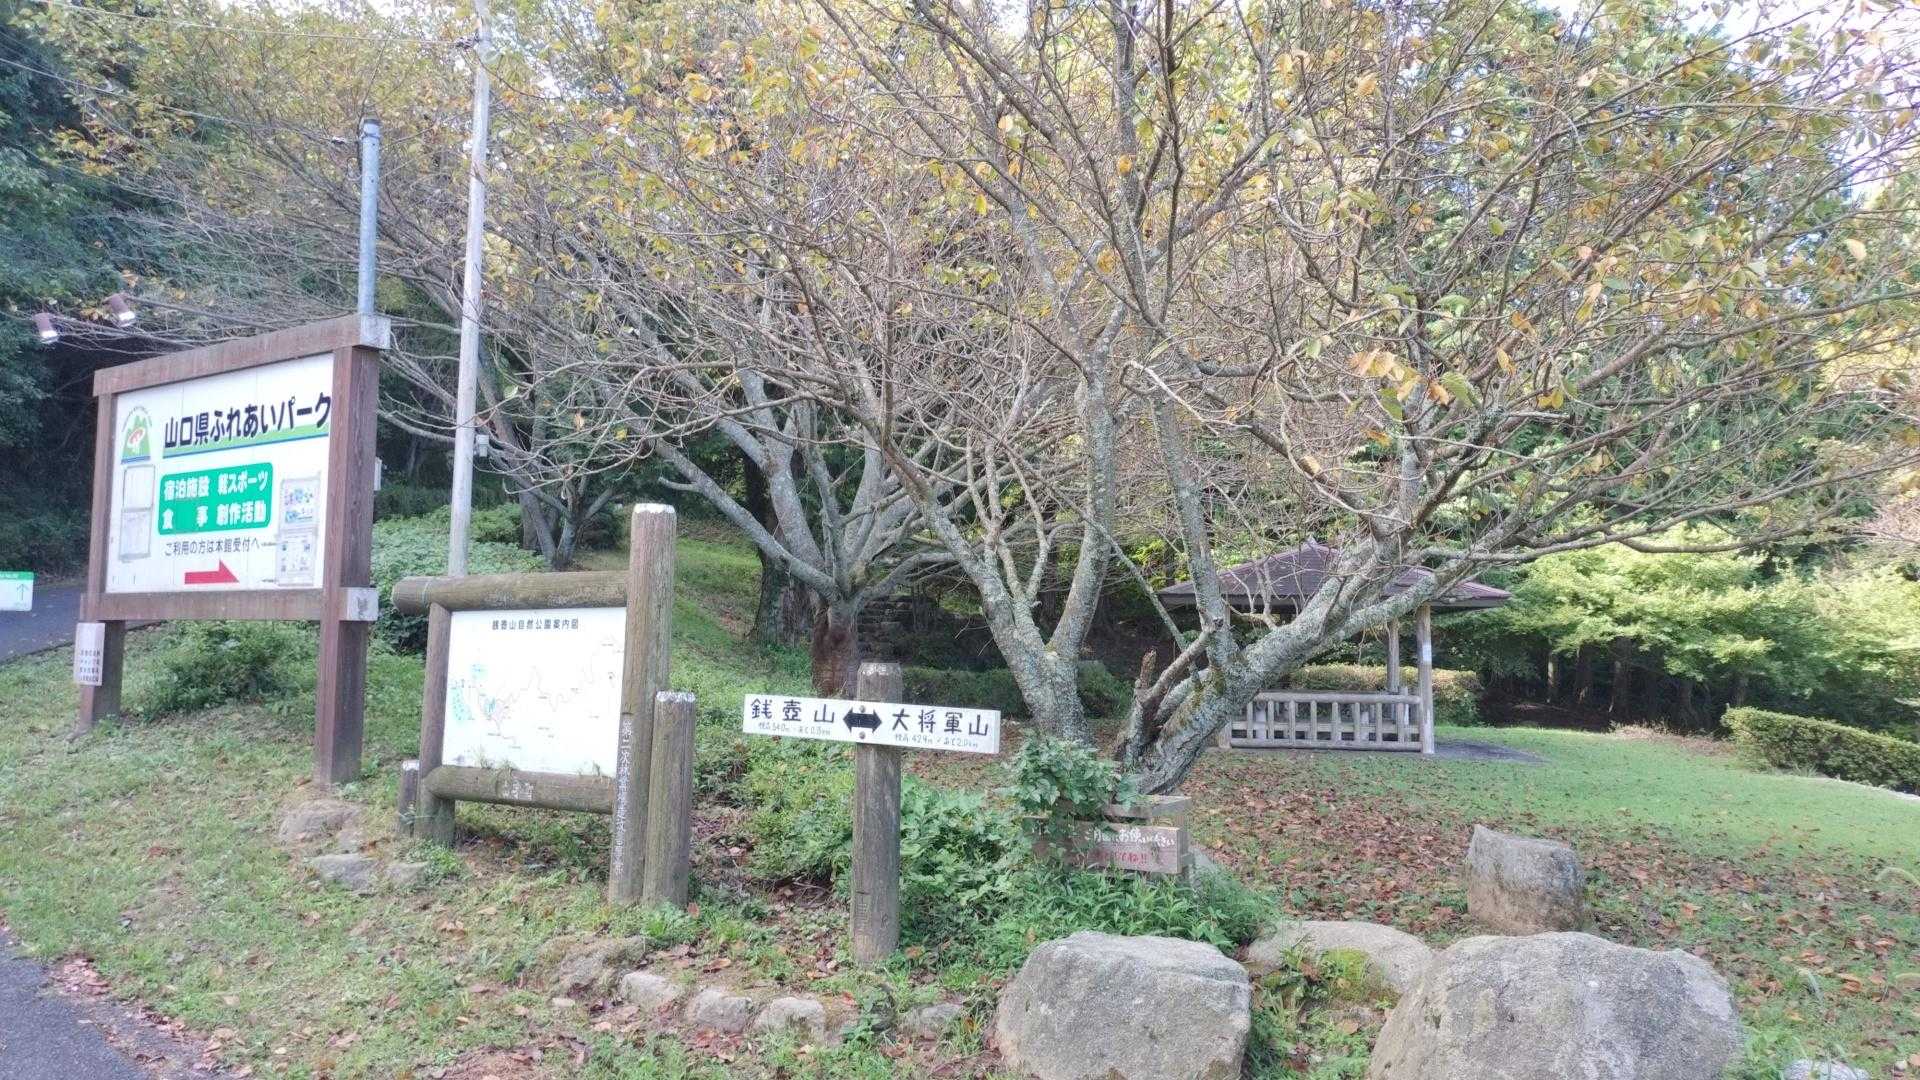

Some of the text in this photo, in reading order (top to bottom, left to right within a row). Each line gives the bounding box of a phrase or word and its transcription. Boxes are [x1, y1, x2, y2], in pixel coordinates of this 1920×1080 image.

[164, 392, 331, 449] 山口県ふれあいパーク
[163, 470, 269, 502] 宿泊施設 軽スポーツ
[216, 500, 267, 526] 創作活動
[164, 537, 260, 556] ご利用の方は本館受付へ
[892, 708, 989, 737] 大将軍山
